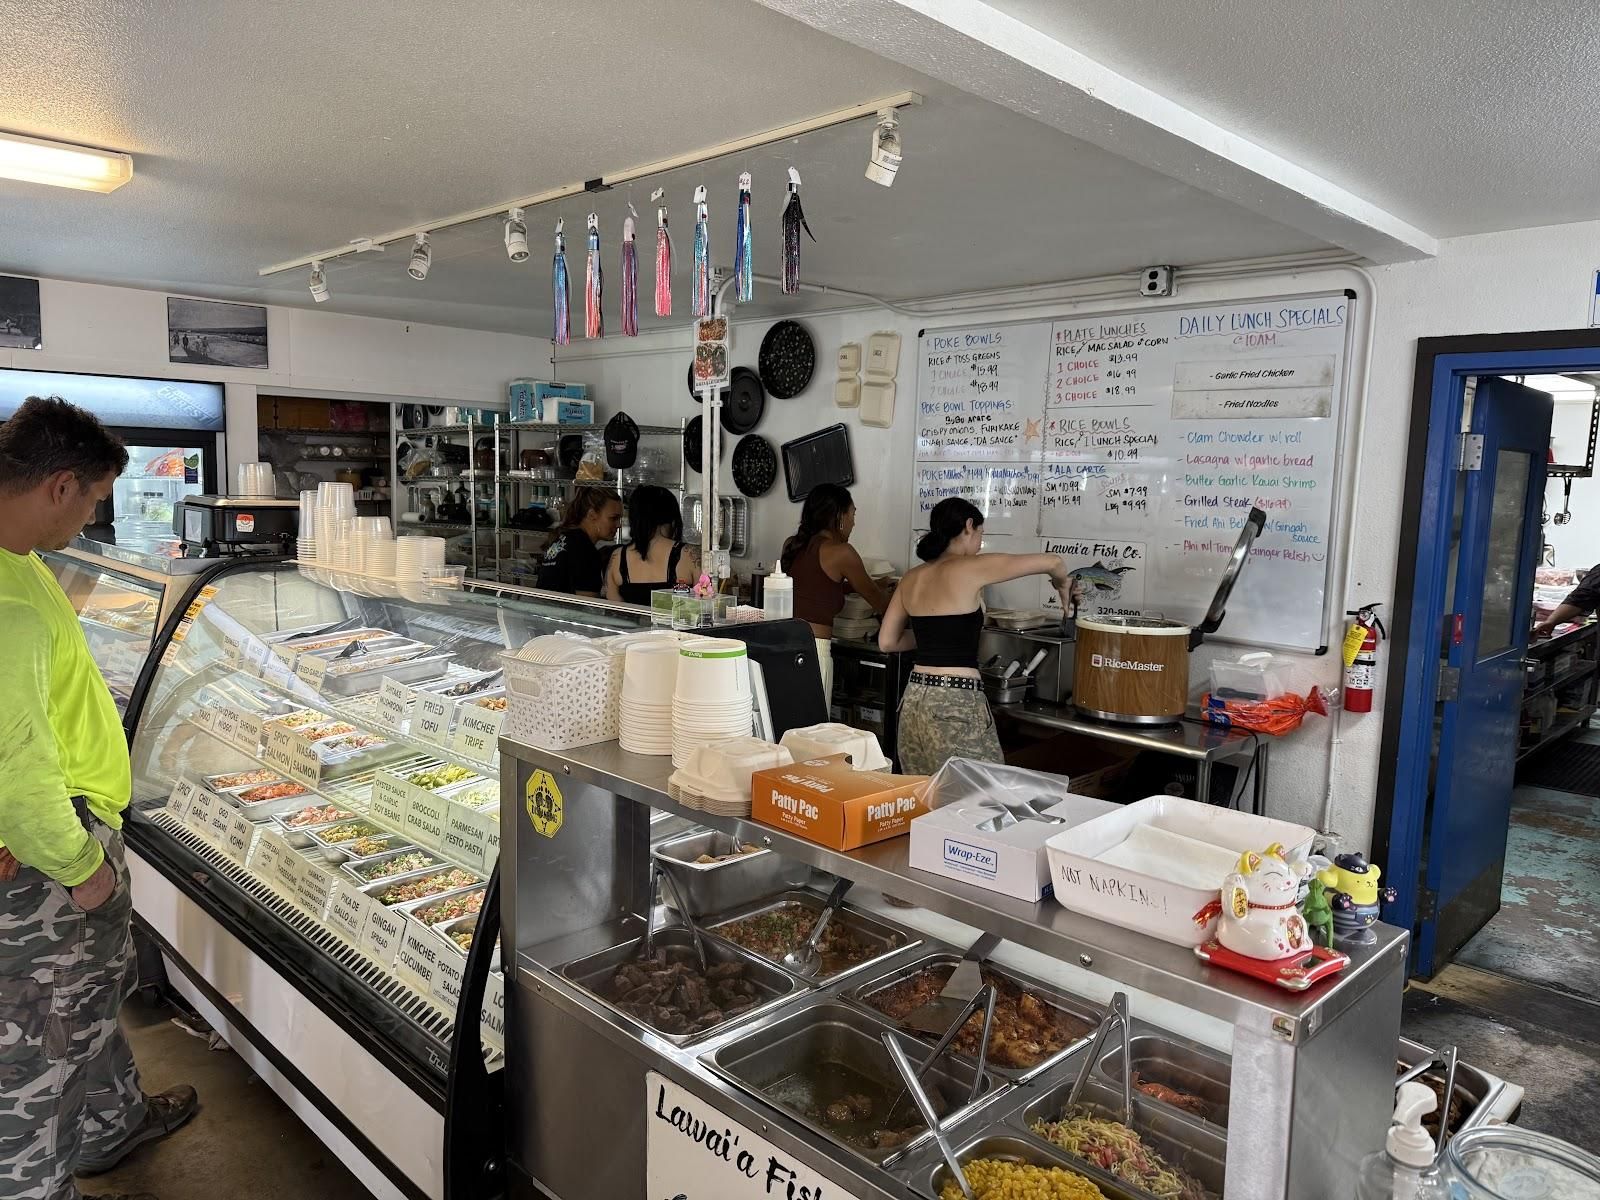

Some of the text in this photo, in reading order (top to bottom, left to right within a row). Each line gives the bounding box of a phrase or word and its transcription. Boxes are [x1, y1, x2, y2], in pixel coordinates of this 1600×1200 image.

[1180, 305, 1346, 335] DAILY LUNCH SPECIALS
[1064, 322, 1146, 342] PLATE LUNCHES
[934, 331, 1002, 350] POKE BOWLS
[1088, 343, 1106, 352] MAC
[1108, 340, 1134, 351] SALAD
[1144, 338, 1168, 347] CORN
[1067, 360, 1099, 372] CHOICE
[1215, 368, 1294, 380] Garlic Fried Chicken
[1065, 374, 1099, 386] CHOICE
[1065, 391, 1098, 402] CHOICE
[1224, 400, 1280, 408] Fried Noodles
[921, 401, 941, 415] POKE
[943, 401, 966, 413] BOWL
[1060, 416, 1132, 433] RICE BOWLS
[1091, 435, 1121, 447] LUNCH
[1187, 432, 1214, 444] Clam
[1218, 431, 1264, 443] Chowder
[1284, 430, 1302, 443] roll
[1107, 448, 1138, 461] $10.99
[1186, 453, 1230, 470] Lasagna
[1250, 455, 1281, 470] garlic
[1283, 453, 1314, 468] bread
[1054, 464, 1072, 475] ALA
[1046, 482, 1057, 492] SM
[1218, 475, 1248, 486] Garlic
[1282, 476, 1317, 490] Shrimp
[1106, 486, 1148, 498] SM $7.99
[1122, 499, 1147, 511] $9.99
[1184, 494, 1218, 508] Grilled
[1223, 496, 1252, 508] Steak
[1184, 516, 1208, 528] Fried
[1292, 534, 1321, 544] sauce
[1045, 540, 1142, 559] Lawai'a Fish Co.
[1103, 658, 1164, 672] RiceMaster
[424, 700, 445, 716] FRIED
[420, 718, 439, 733] TOFU
[463, 716, 496, 735] KIMCHEE
[274, 730, 290, 746] SPICY
[464, 734, 484, 750] TRIPE
[266, 746, 291, 767] SALMON
[296, 742, 318, 761] WASABI
[292, 760, 317, 780] SALMON
[392, 786, 406, 799] SAUCE
[383, 794, 398, 808] GARLIC
[772, 790, 819, 820] Patty Pac
[868, 796, 916, 822] Patty Pac
[374, 802, 400, 822] SOY BEANS
[412, 800, 440, 820] BROCCOLI
[407, 814, 441, 836] CRAB SALAD
[782, 812, 806, 826] Patty Paper
[879, 816, 904, 828] Patty Paper
[450, 818, 484, 840] PARMESAN
[445, 832, 483, 857] PESTO PASTA
[948, 844, 992, 866] Wrap-Eze
[1062, 865, 1082, 886] NOT
[334, 904, 349, 921] GALLO
[352, 901, 360, 912] DE
[372, 912, 396, 938] GINGAH
[370, 931, 388, 948] SPREAD
[407, 936, 436, 964] KIMCHEE
[438, 960, 460, 981] POTATO
[656, 1084, 759, 1178] Lawai'a
